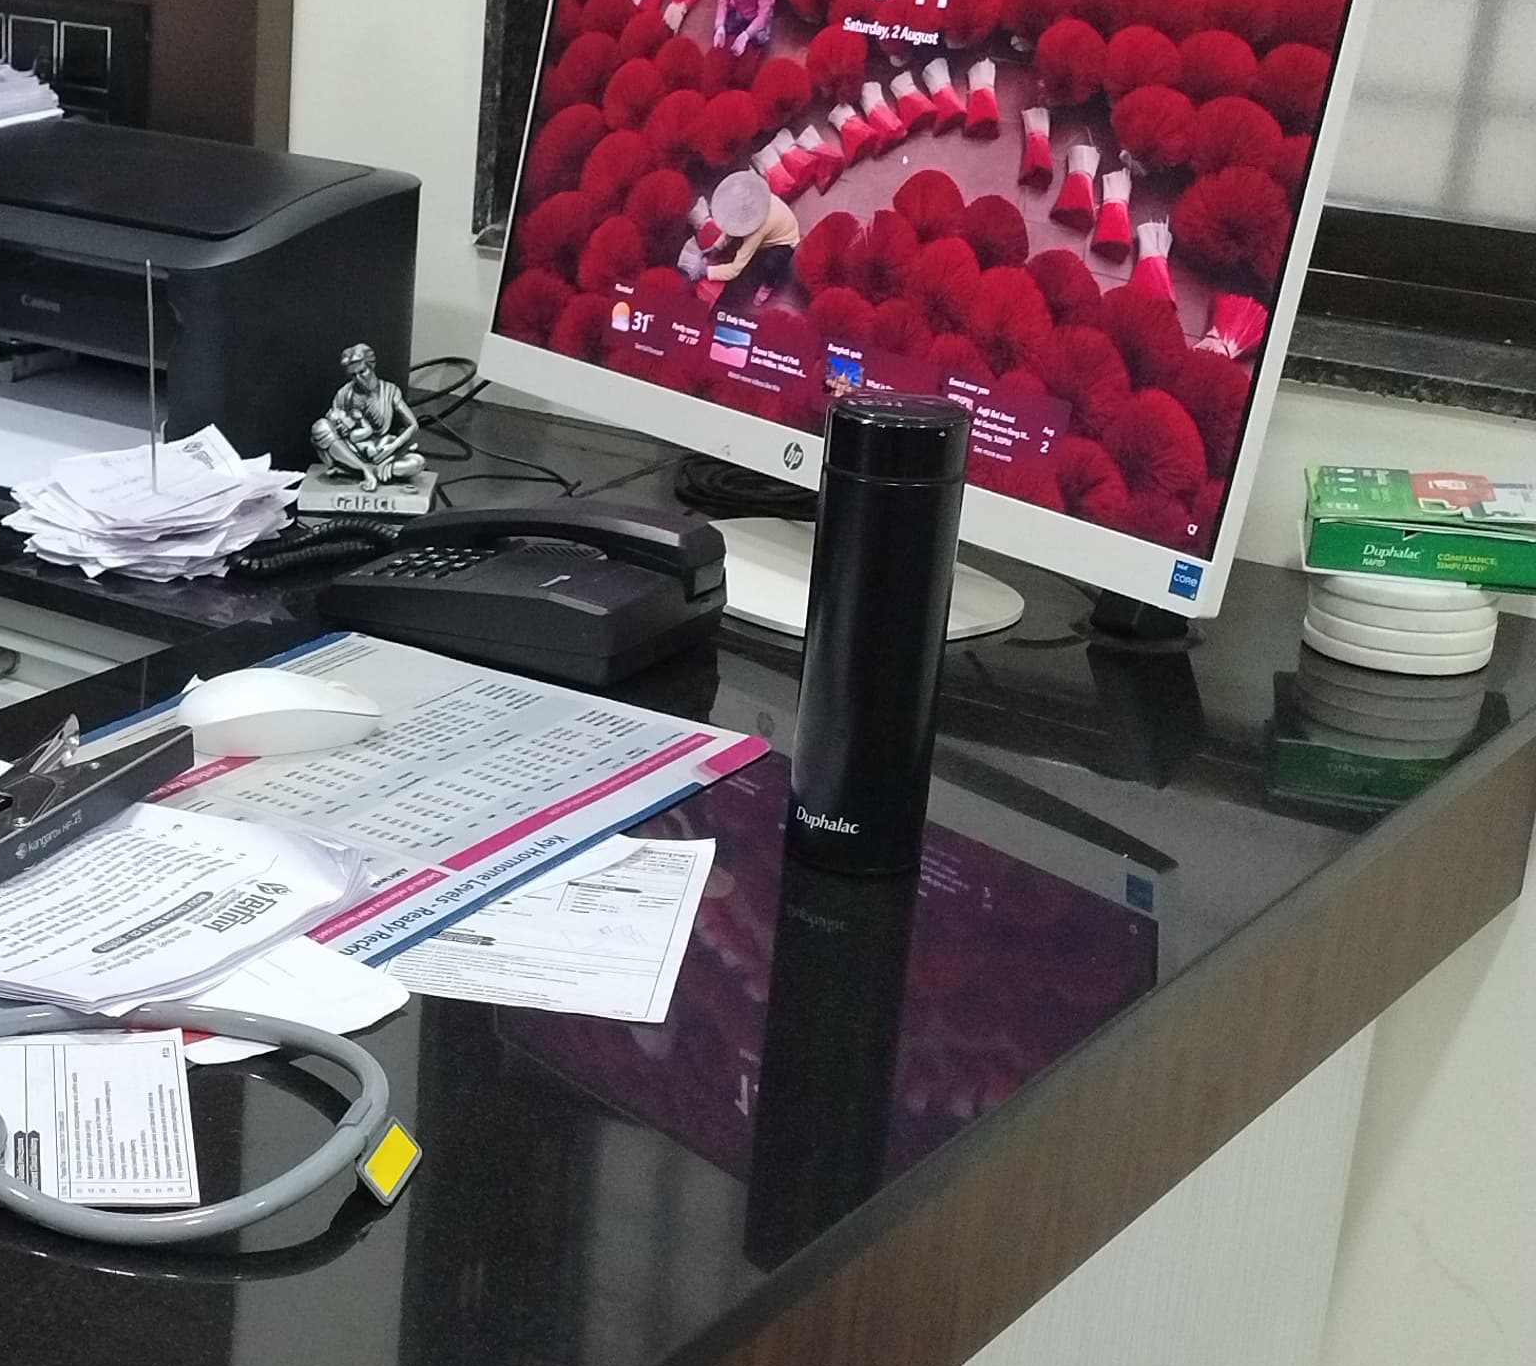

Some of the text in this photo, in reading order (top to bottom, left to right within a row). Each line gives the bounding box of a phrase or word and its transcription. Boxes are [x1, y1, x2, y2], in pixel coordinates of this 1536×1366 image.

[843, 17, 939, 46] Saturday, 2 August
[784, 442, 804, 470] hp
[1039, 439, 1050, 454] 2
[1362, 543, 1421, 561] Duphalac
[795, 805, 860, 834] Duphalac
[538, 834, 570, 856] Key
[477, 848, 543, 880] Hormone
[435, 878, 485, 900] Levels
[380, 906, 432, 933] Ready
[337, 930, 392, 957] Reckn
